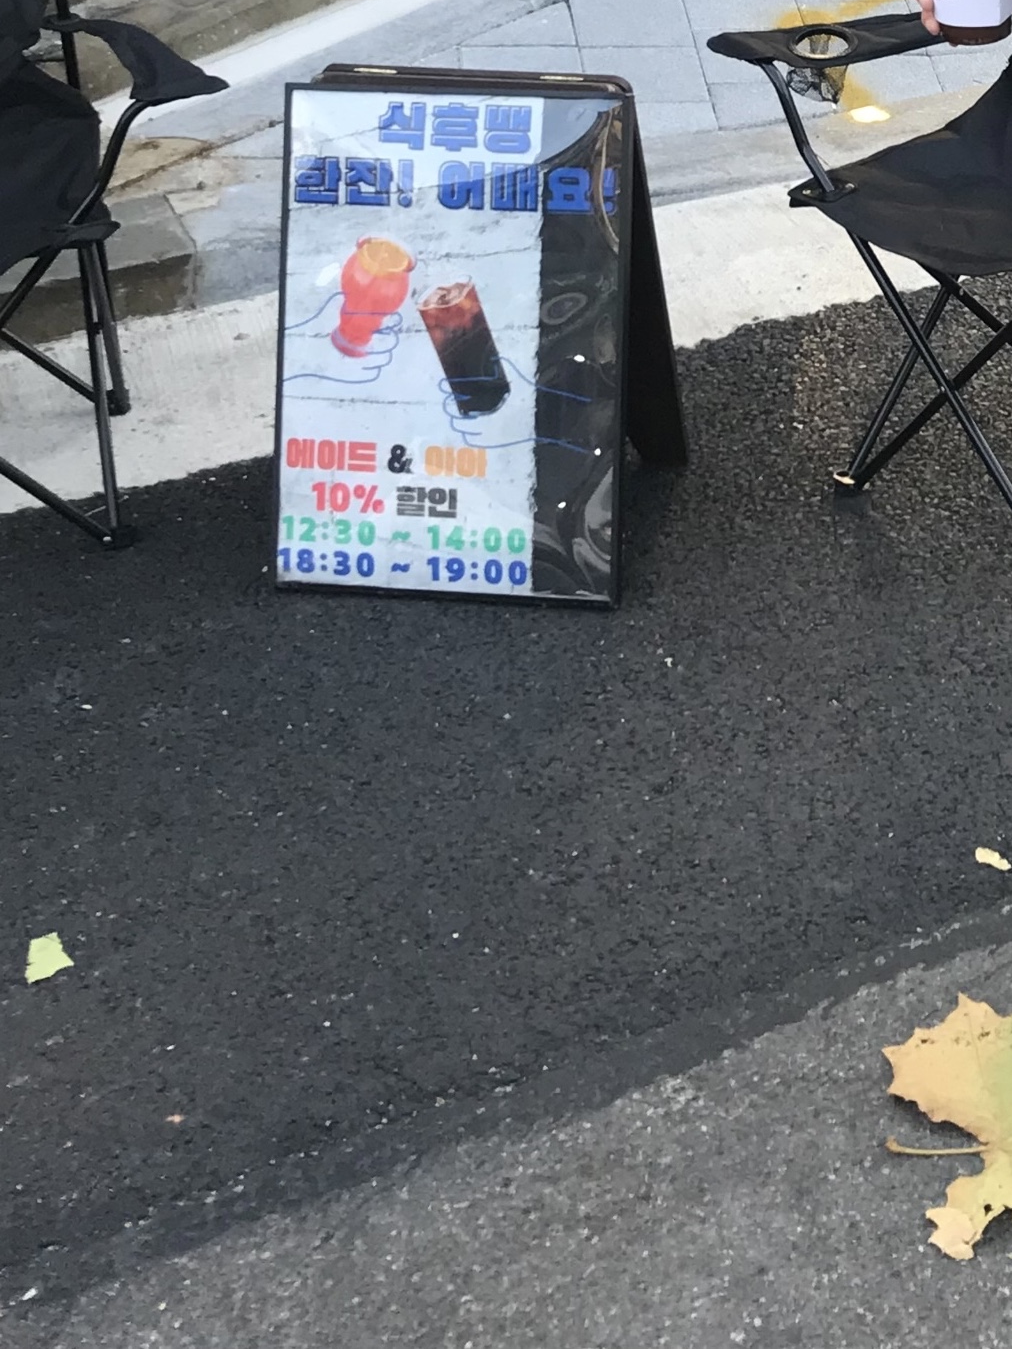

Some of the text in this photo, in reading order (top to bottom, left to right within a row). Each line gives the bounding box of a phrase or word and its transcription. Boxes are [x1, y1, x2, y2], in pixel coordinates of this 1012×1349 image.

[378, 102, 532, 154] 식후땡
[294, 155, 619, 216] 한잔! 어때요!
[286, 437, 378, 473] 에이드
[387, 444, 413, 475] &
[311, 481, 458, 519] 10% 할인
[282, 515, 376, 547] 12:30
[426, 524, 526, 555] 14:00
[277, 546, 375, 578] 18:30
[426, 556, 528, 586] 19:00
